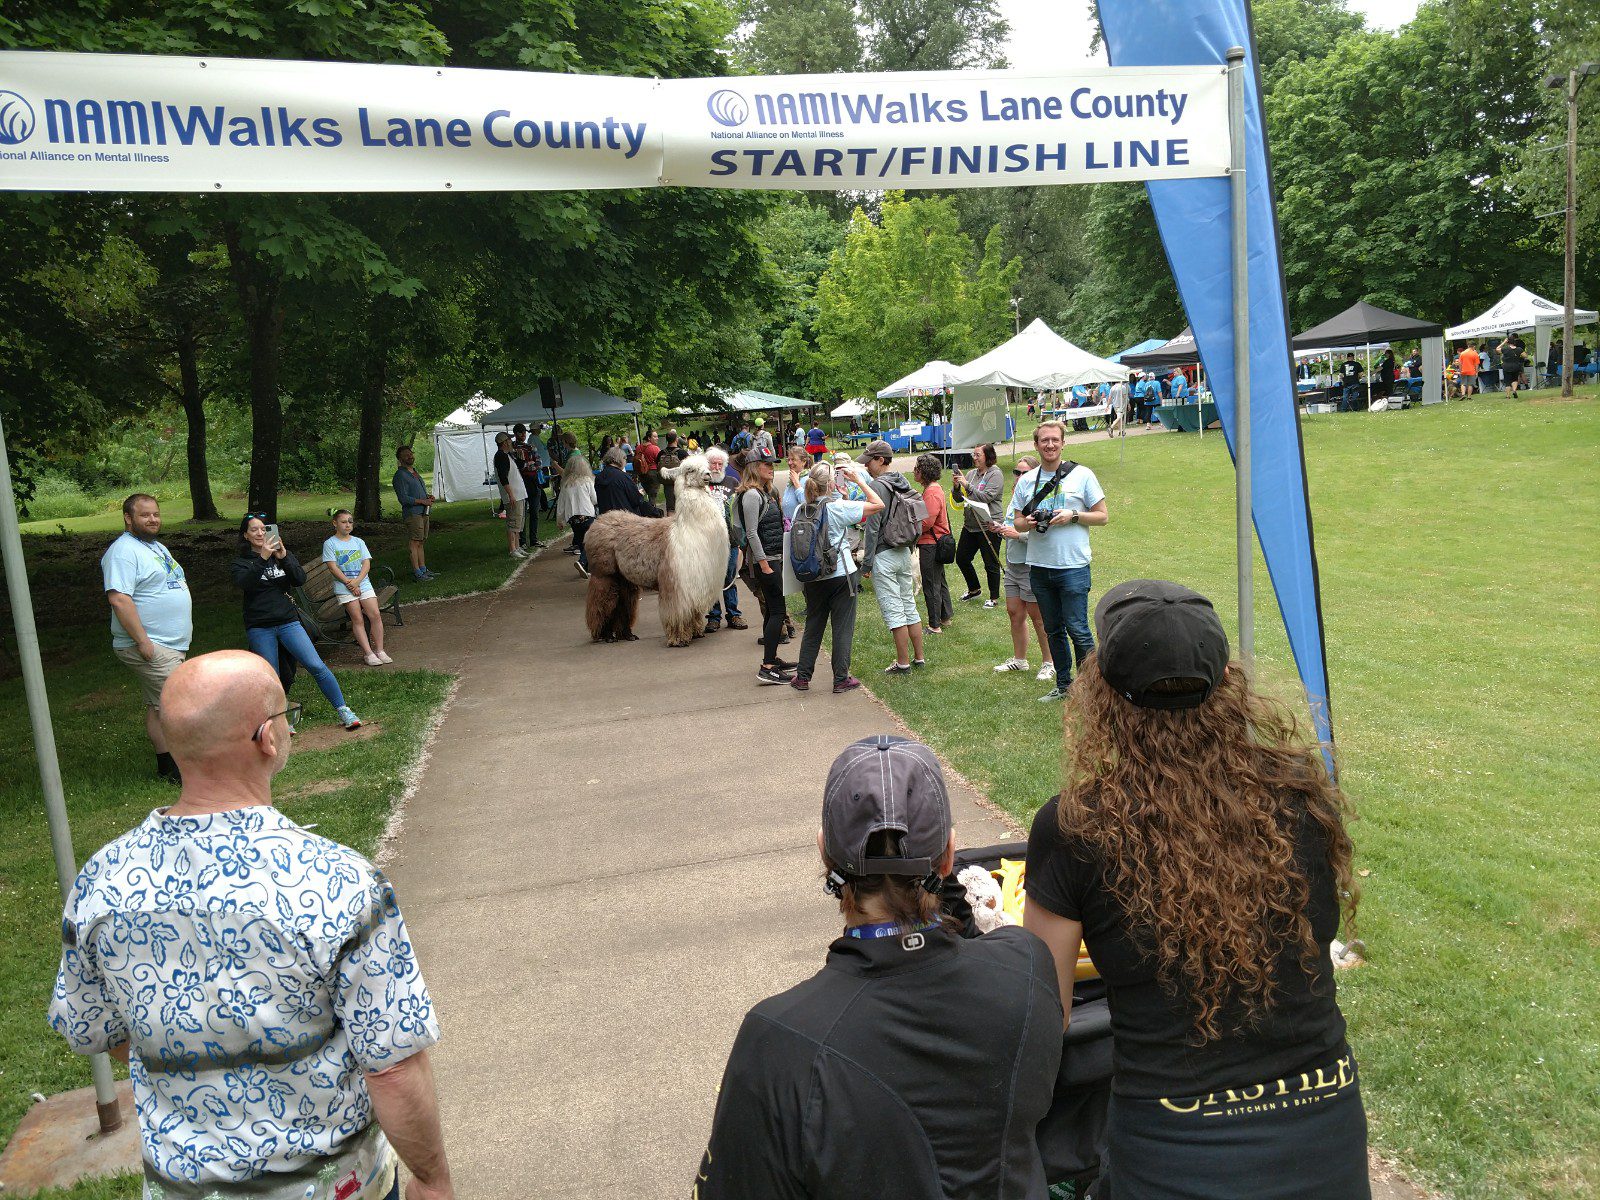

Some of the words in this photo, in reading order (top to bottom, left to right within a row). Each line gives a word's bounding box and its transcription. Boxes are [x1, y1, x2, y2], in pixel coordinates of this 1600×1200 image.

[755, 92, 967, 125] NAMIWalks
[980, 90, 1063, 121] Lane
[1070, 88, 1188, 125] County
[45, 98, 342, 148] NAMIWalks
[358, 107, 473, 148] Lane
[483, 110, 646, 160] County
[711, 131, 744, 139] National
[746, 131, 778, 139] Alliance
[819, 130, 845, 138] Illness
[30, 151, 75, 161] Alliance
[78, 153, 92, 162] on
[95, 152, 131, 162] Mental
[134, 152, 170, 163] Illness
[709, 142, 1066, 178] START/FINISH
[1086, 138, 1190, 169] LINE
[1226, 1102, 1276, 1117] KITCHEN
[1282, 1101, 1289, 1109] &
[1294, 1096, 1321, 1107] BATH
